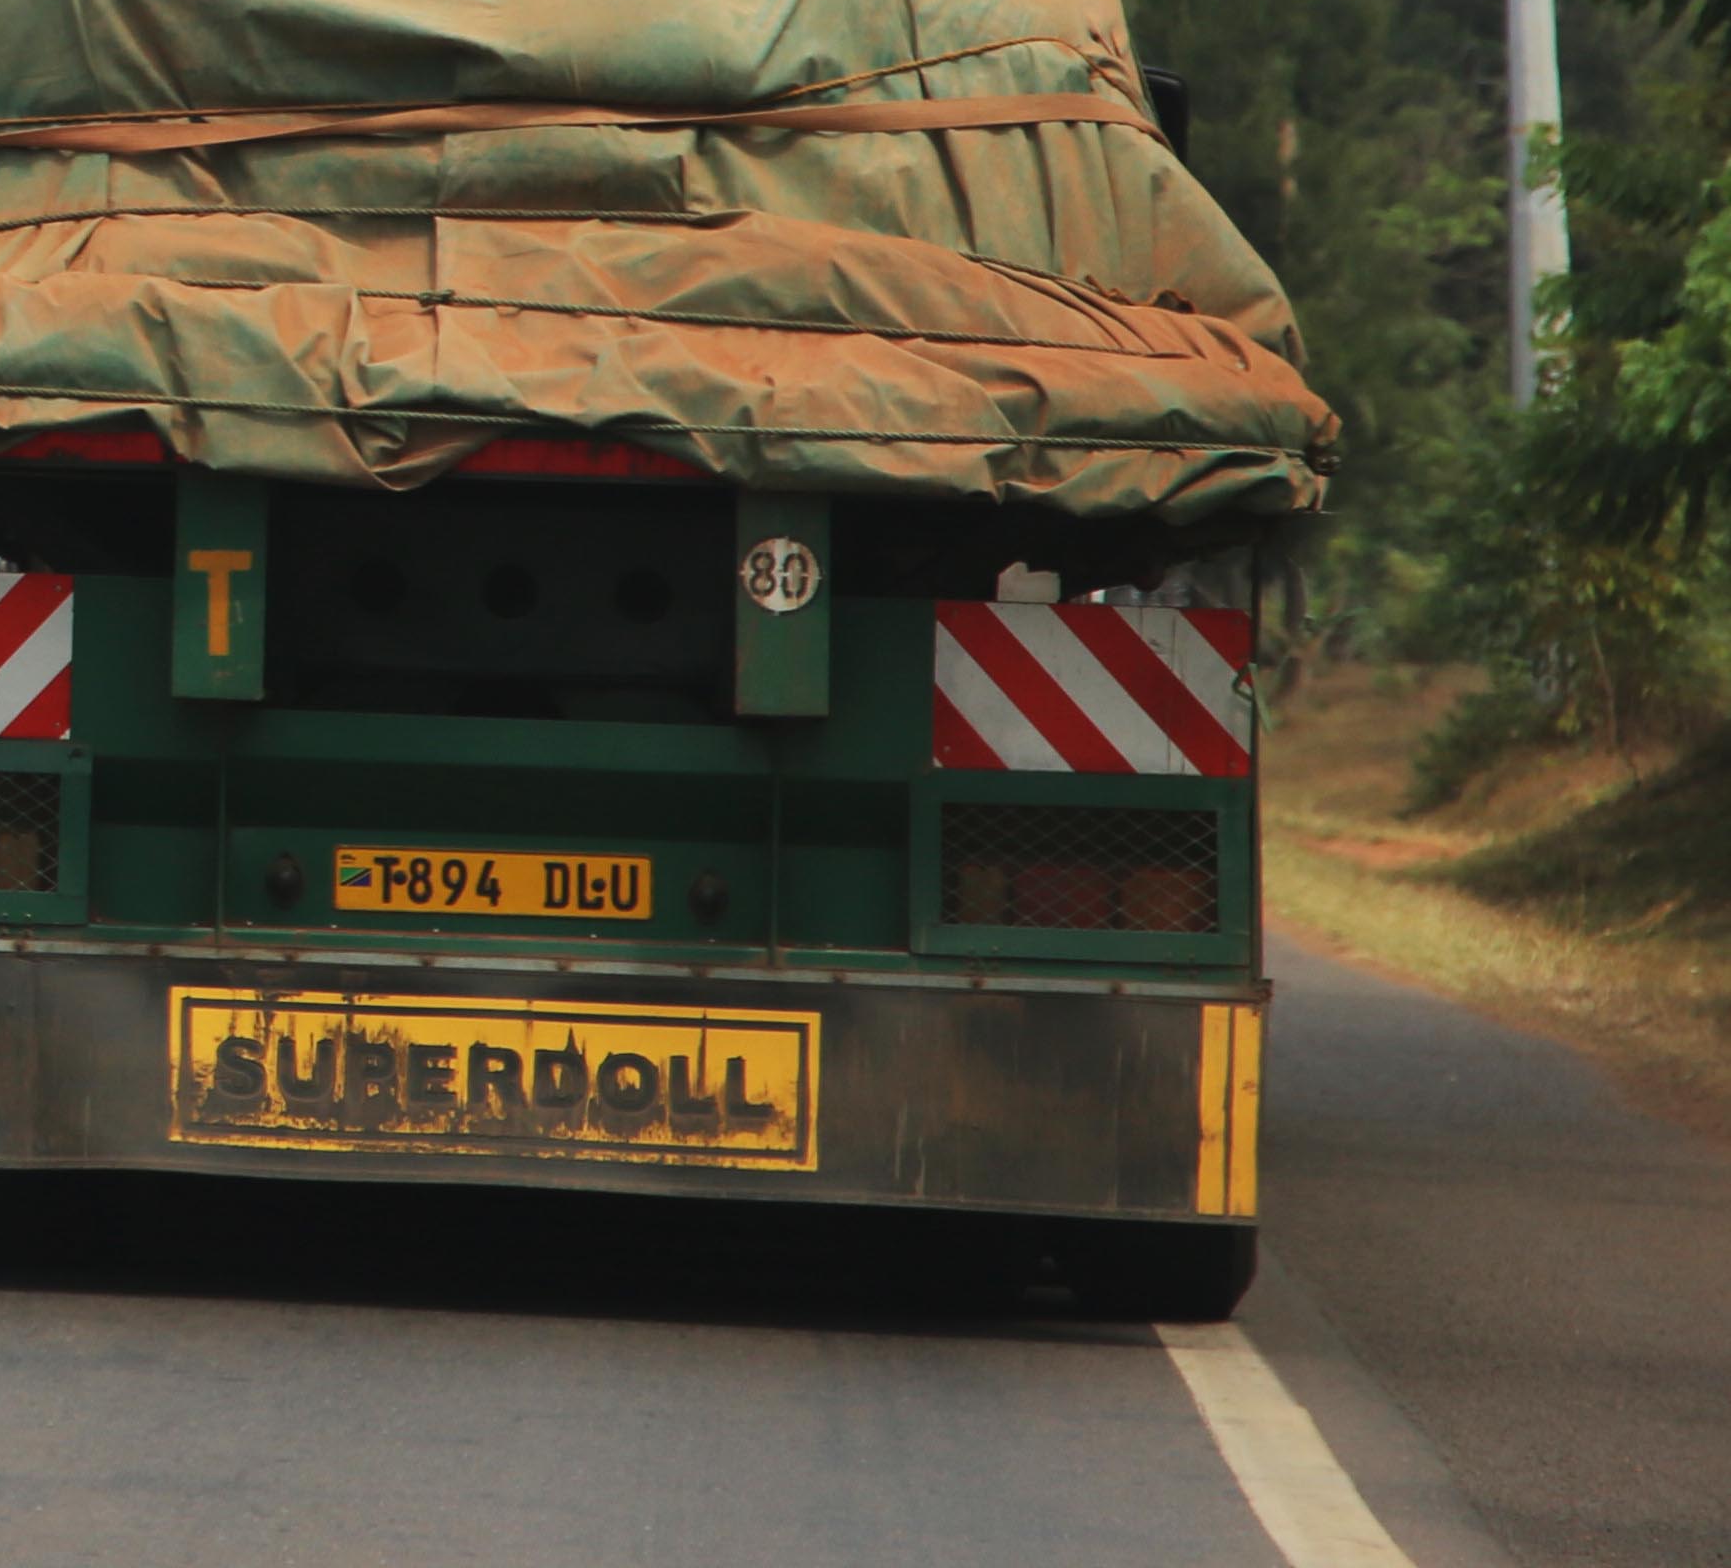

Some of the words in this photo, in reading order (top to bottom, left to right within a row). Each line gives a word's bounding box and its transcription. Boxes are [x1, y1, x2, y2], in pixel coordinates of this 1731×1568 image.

[189, 550, 252, 656] T
[749, 551, 809, 599] 80
[544, 861, 639, 912] DLU
[214, 1034, 775, 1120] SUPERDOLL
